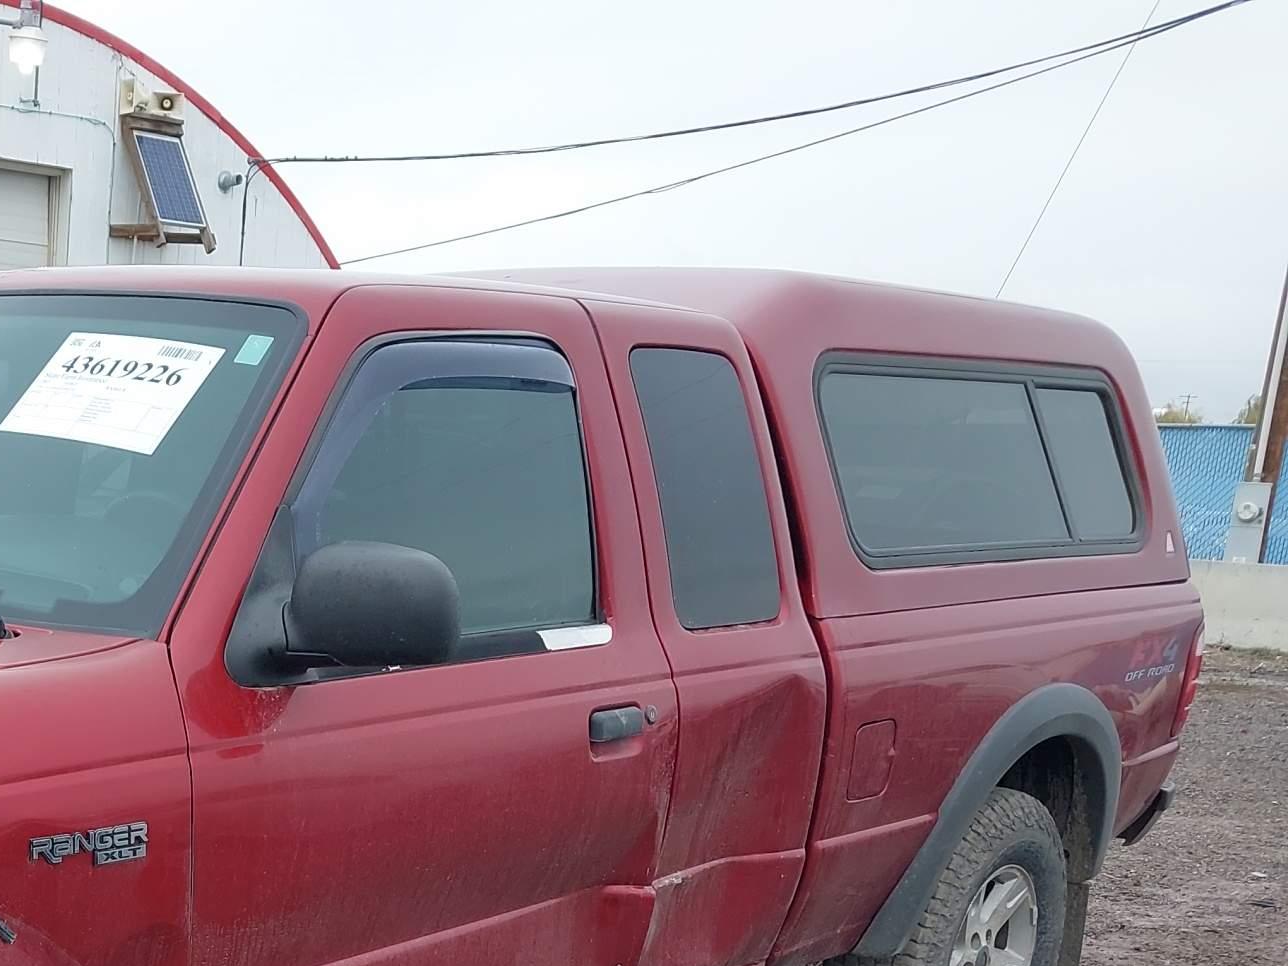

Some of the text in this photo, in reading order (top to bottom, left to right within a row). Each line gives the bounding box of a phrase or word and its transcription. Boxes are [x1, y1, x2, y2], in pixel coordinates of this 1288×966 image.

[61, 355, 188, 386] 43619226
[1125, 669, 1145, 682] OFF
[29, 821, 149, 864] RANGER
[103, 847, 139, 862] XLT
